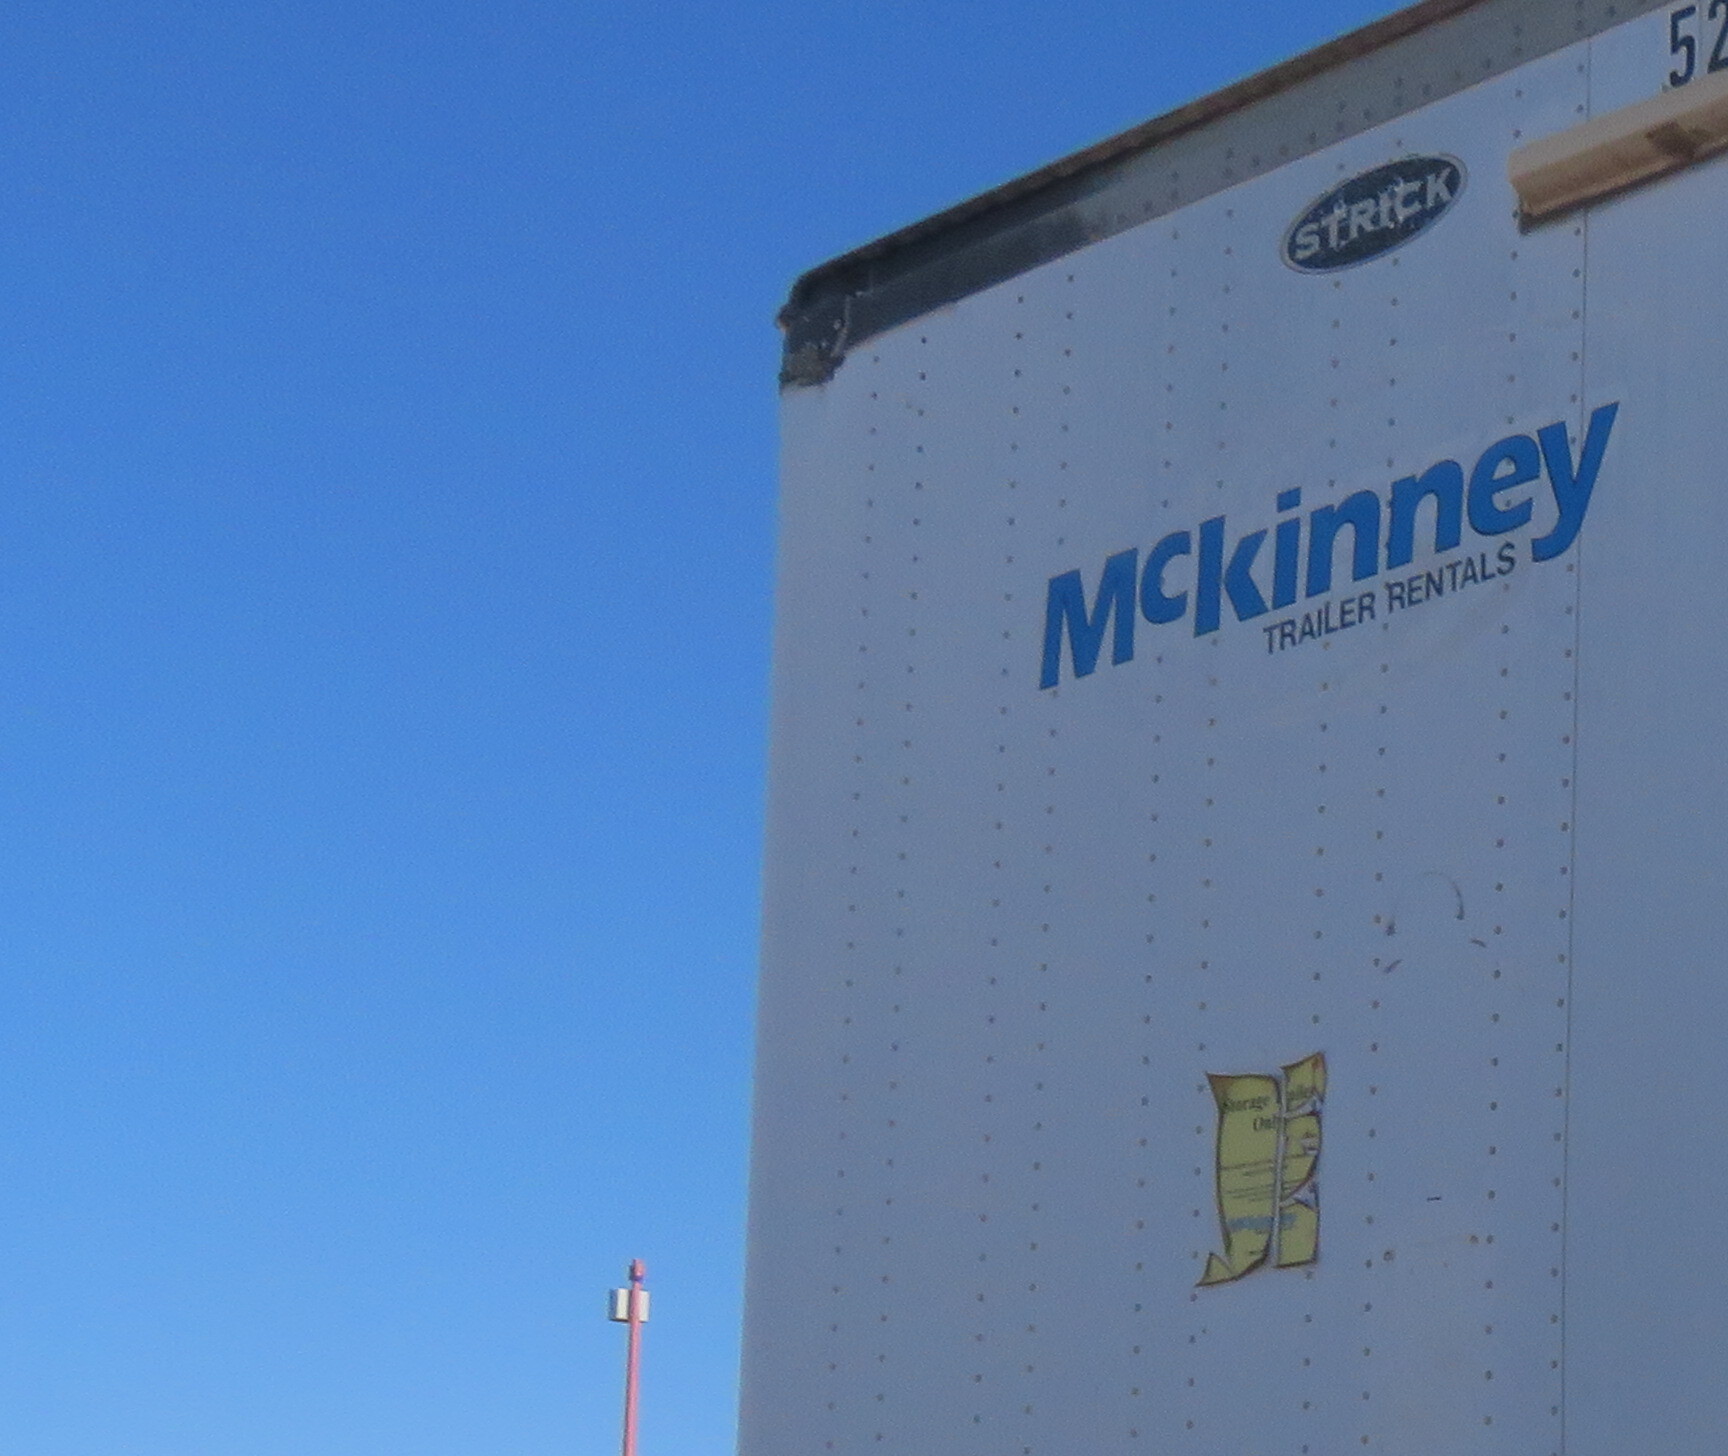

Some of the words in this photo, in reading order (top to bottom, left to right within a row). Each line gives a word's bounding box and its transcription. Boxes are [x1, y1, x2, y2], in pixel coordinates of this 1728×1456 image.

[1295, 168, 1452, 260] STRICK
[1262, 591, 1376, 655] TRAILER
[1385, 541, 1517, 615] RENTALS
